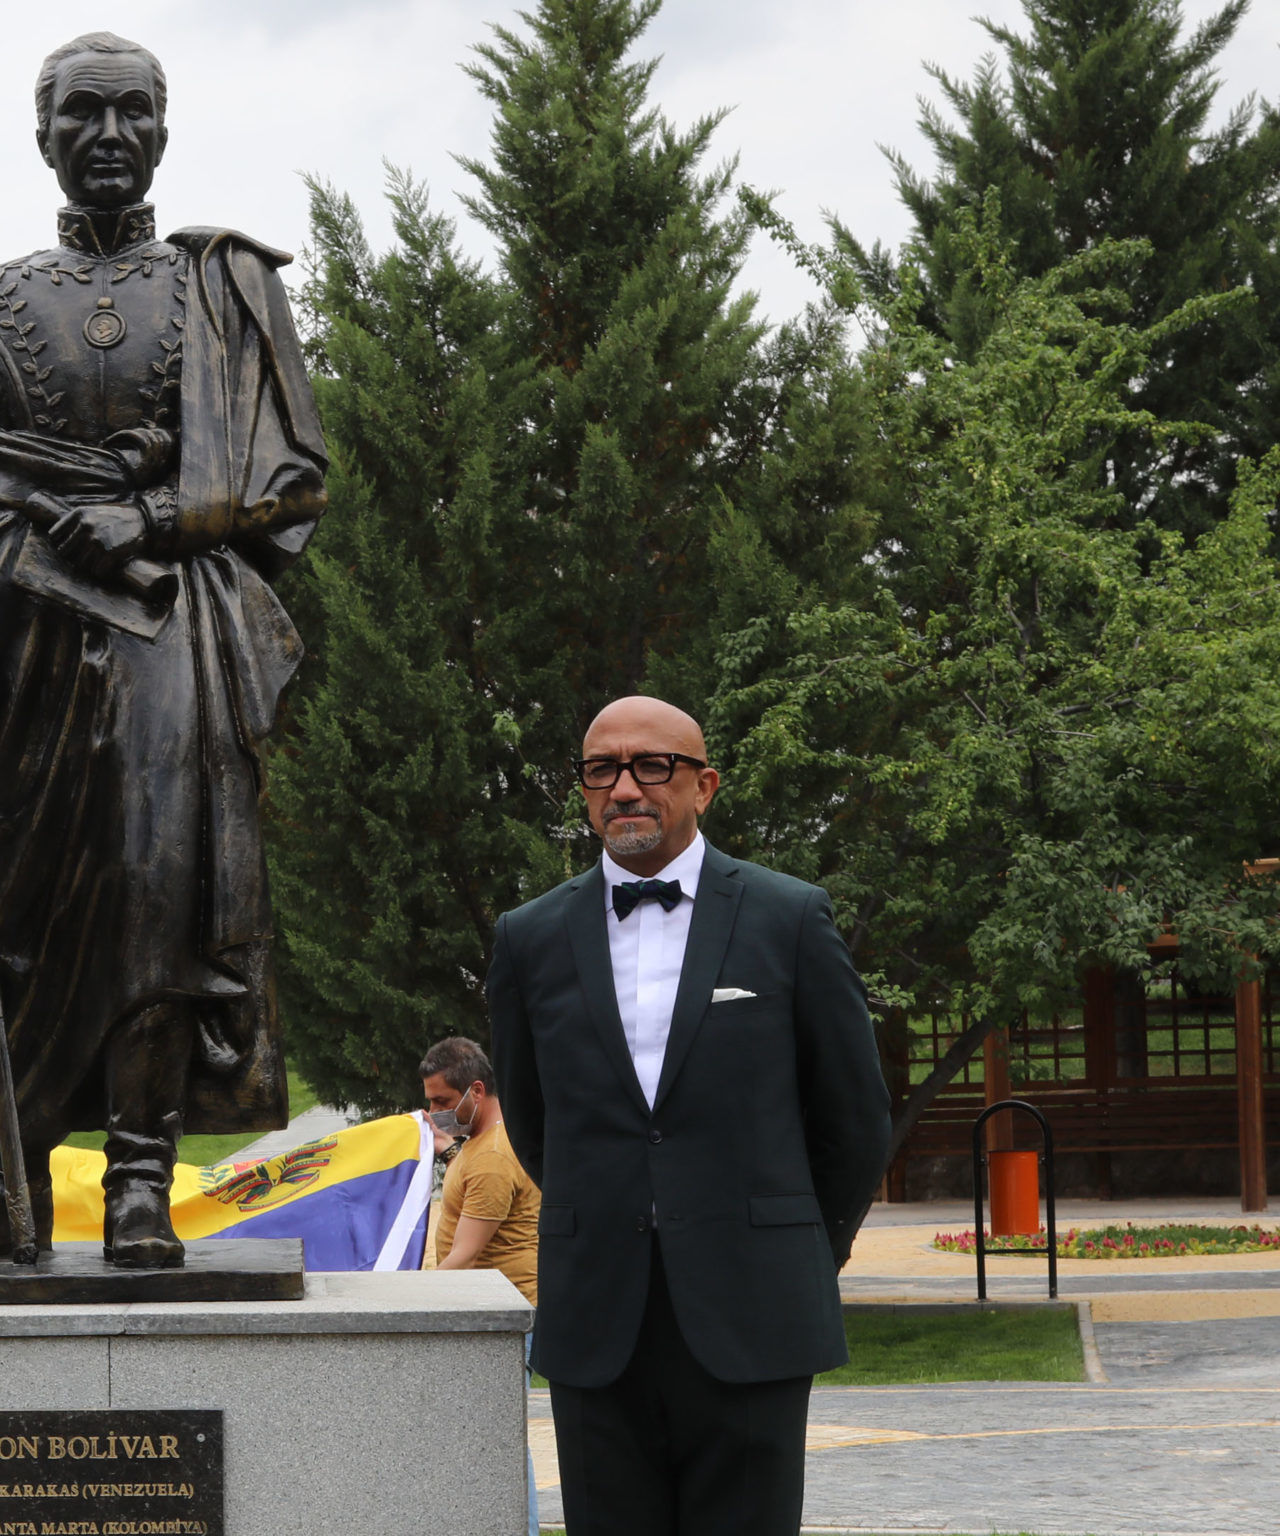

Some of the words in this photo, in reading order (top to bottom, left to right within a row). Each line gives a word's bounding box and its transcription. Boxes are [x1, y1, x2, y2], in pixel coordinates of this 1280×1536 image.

[47, 1430, 180, 1459] BOLİVAR
[82, 1483, 194, 1499] (VENEZUELA)
[41, 1521, 99, 1535] MARTA
[102, 1518, 207, 1536] (KOLOMBİYA)
